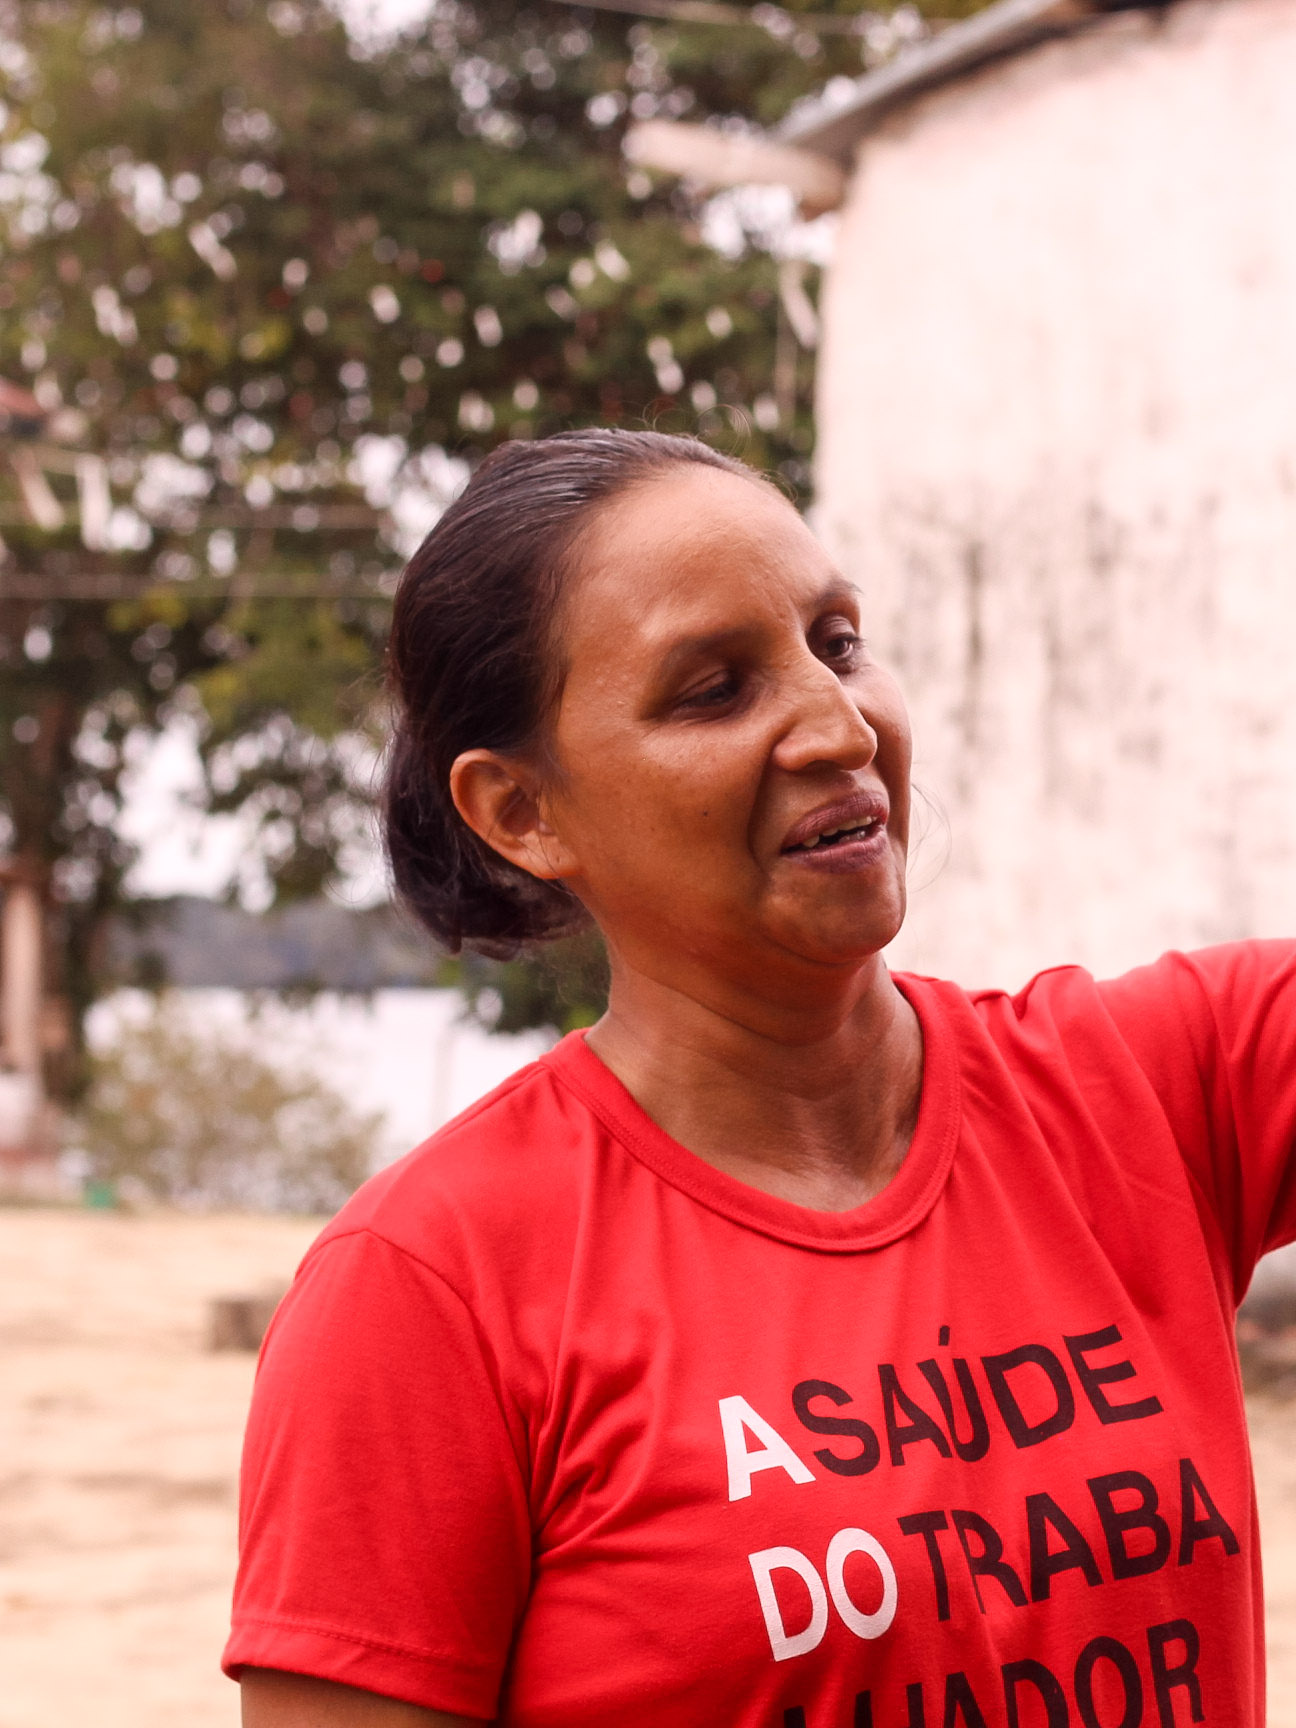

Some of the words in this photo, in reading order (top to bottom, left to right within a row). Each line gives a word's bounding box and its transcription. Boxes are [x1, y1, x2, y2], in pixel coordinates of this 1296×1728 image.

[718, 1394, 817, 1502] A
[790, 1324, 1165, 1477] SAÚDE
[747, 1526, 899, 1662] DO
[898, 1457, 1241, 1622] TRABA
[783, 1618, 1206, 1728] ADOR
